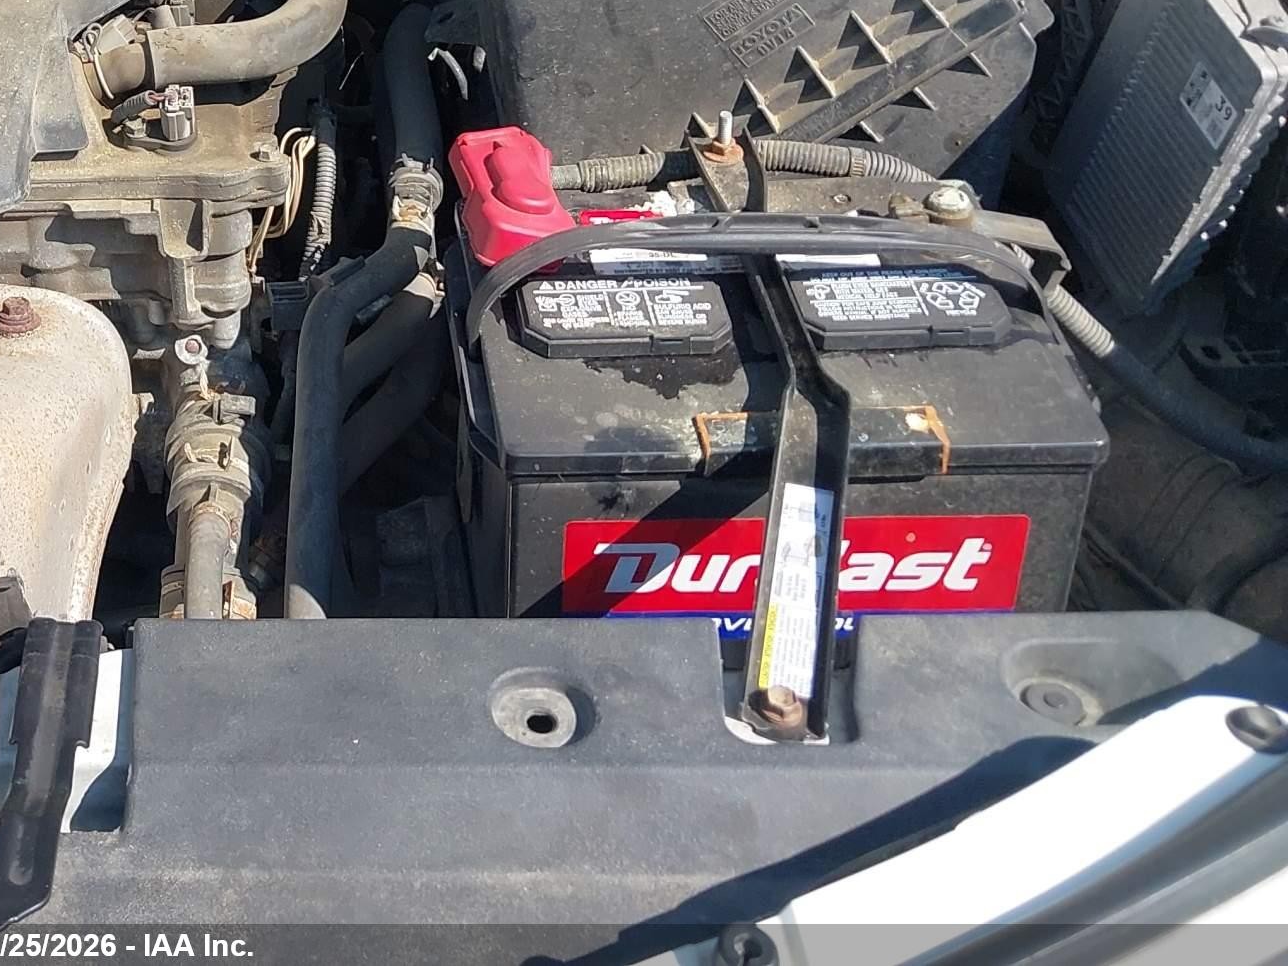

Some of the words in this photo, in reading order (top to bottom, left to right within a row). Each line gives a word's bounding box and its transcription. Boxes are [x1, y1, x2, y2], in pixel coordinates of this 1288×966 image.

[733, 6, 803, 54] TOYOTA
[555, 280, 618, 290] DANGER
[594, 537, 992, 592] Durast
